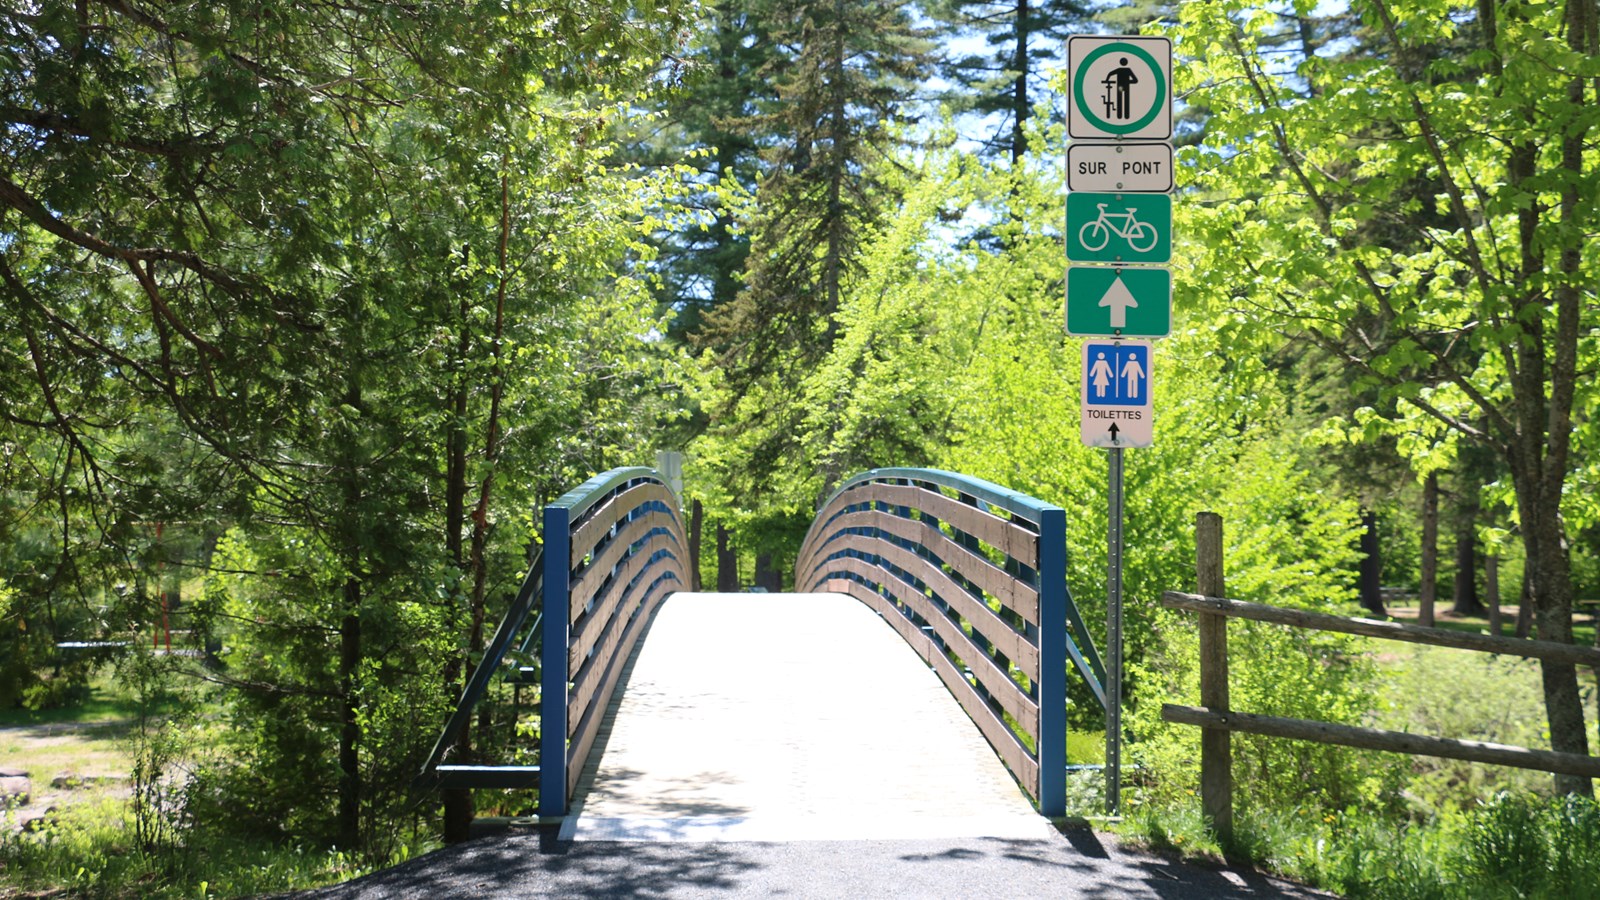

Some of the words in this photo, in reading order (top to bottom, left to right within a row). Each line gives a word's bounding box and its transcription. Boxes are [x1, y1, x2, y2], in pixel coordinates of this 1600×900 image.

[1078, 161, 1107, 175] SUR
[1122, 161, 1161, 175] PONT
[1087, 409, 1142, 420] TOILETTES
